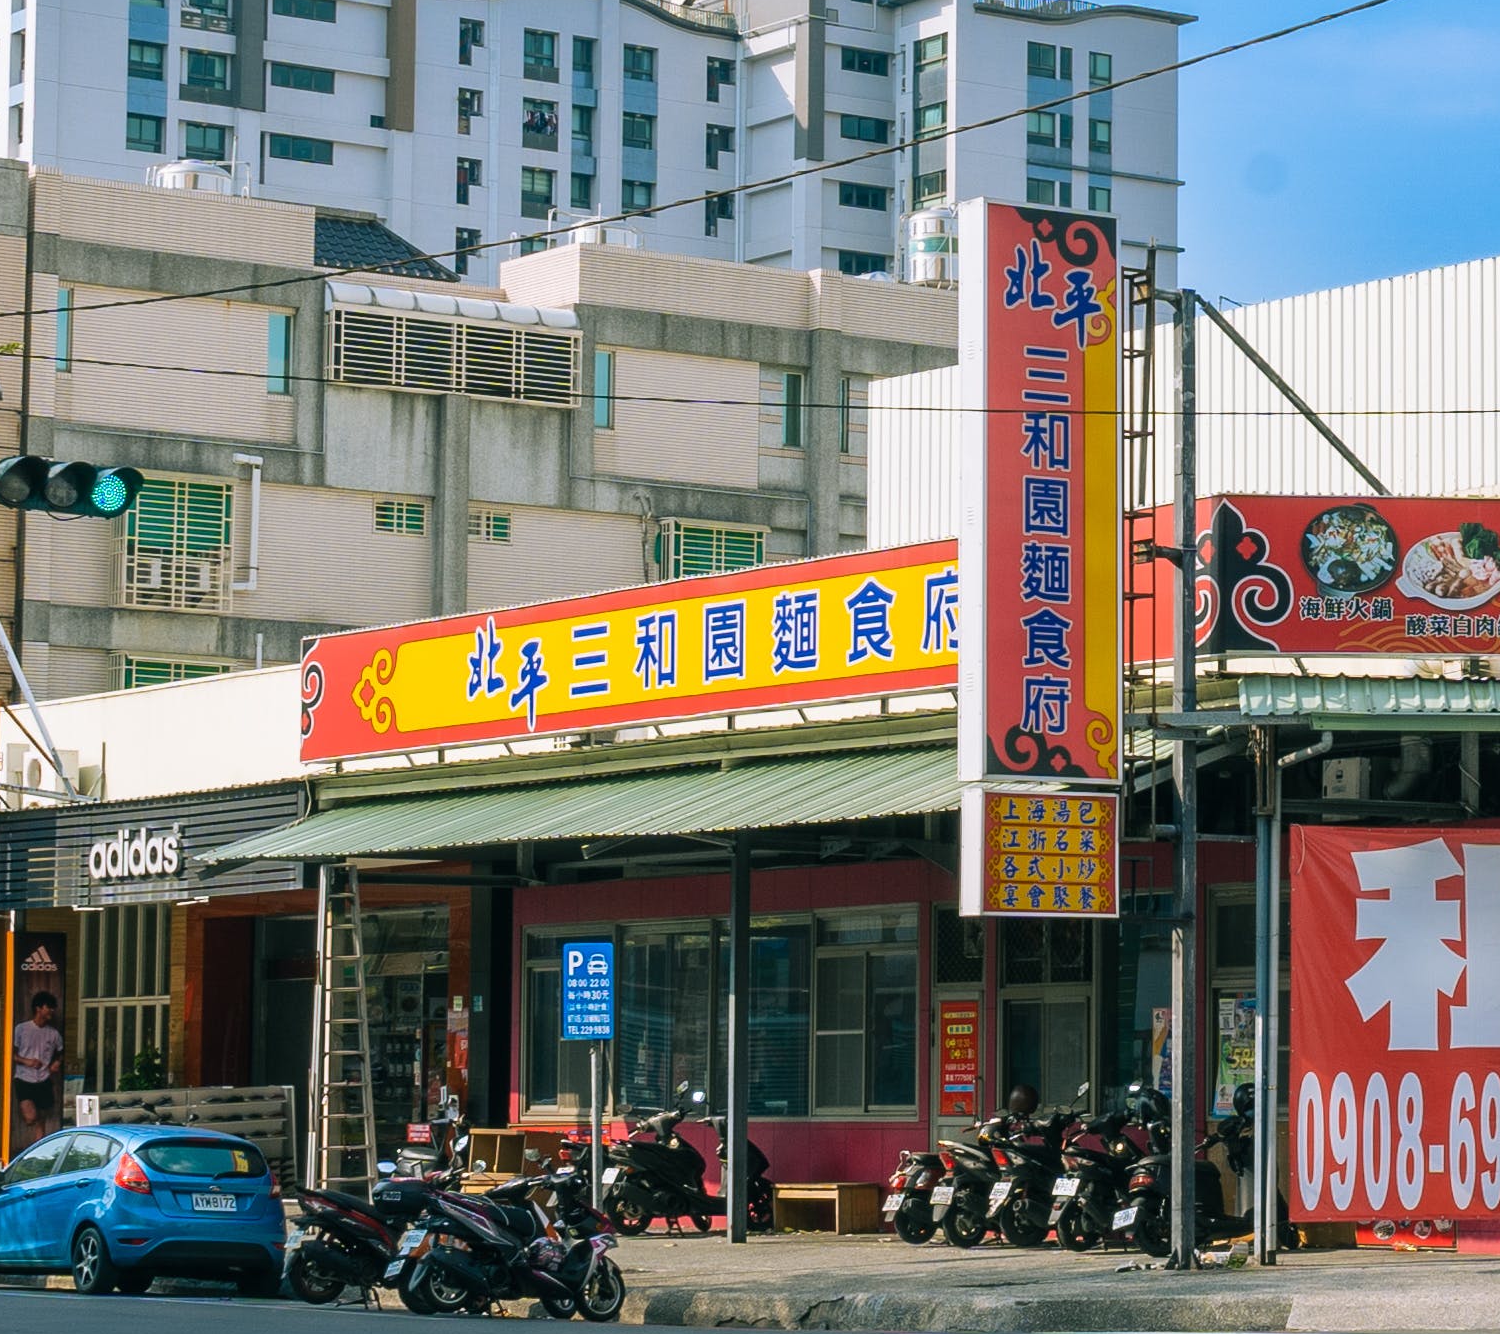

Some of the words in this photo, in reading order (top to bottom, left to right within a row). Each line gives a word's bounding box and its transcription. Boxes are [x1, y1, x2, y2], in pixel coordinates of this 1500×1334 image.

[1004, 240, 1104, 736] 北平三和園麵食府
[1300, 595, 1393, 622] 海鮮火鍋
[467, 566, 959, 733] 北平三和園麵食府
[1002, 797, 1097, 824] 上海湯包
[89, 826, 181, 879] adidas
[1002, 826, 1097, 853] 江浙名菜
[1001, 855, 1097, 882] 各式小炒
[1001, 883, 1097, 910] 宴會聚餐
[21, 961, 58, 972] adidas
[568, 950, 584, 976] P
